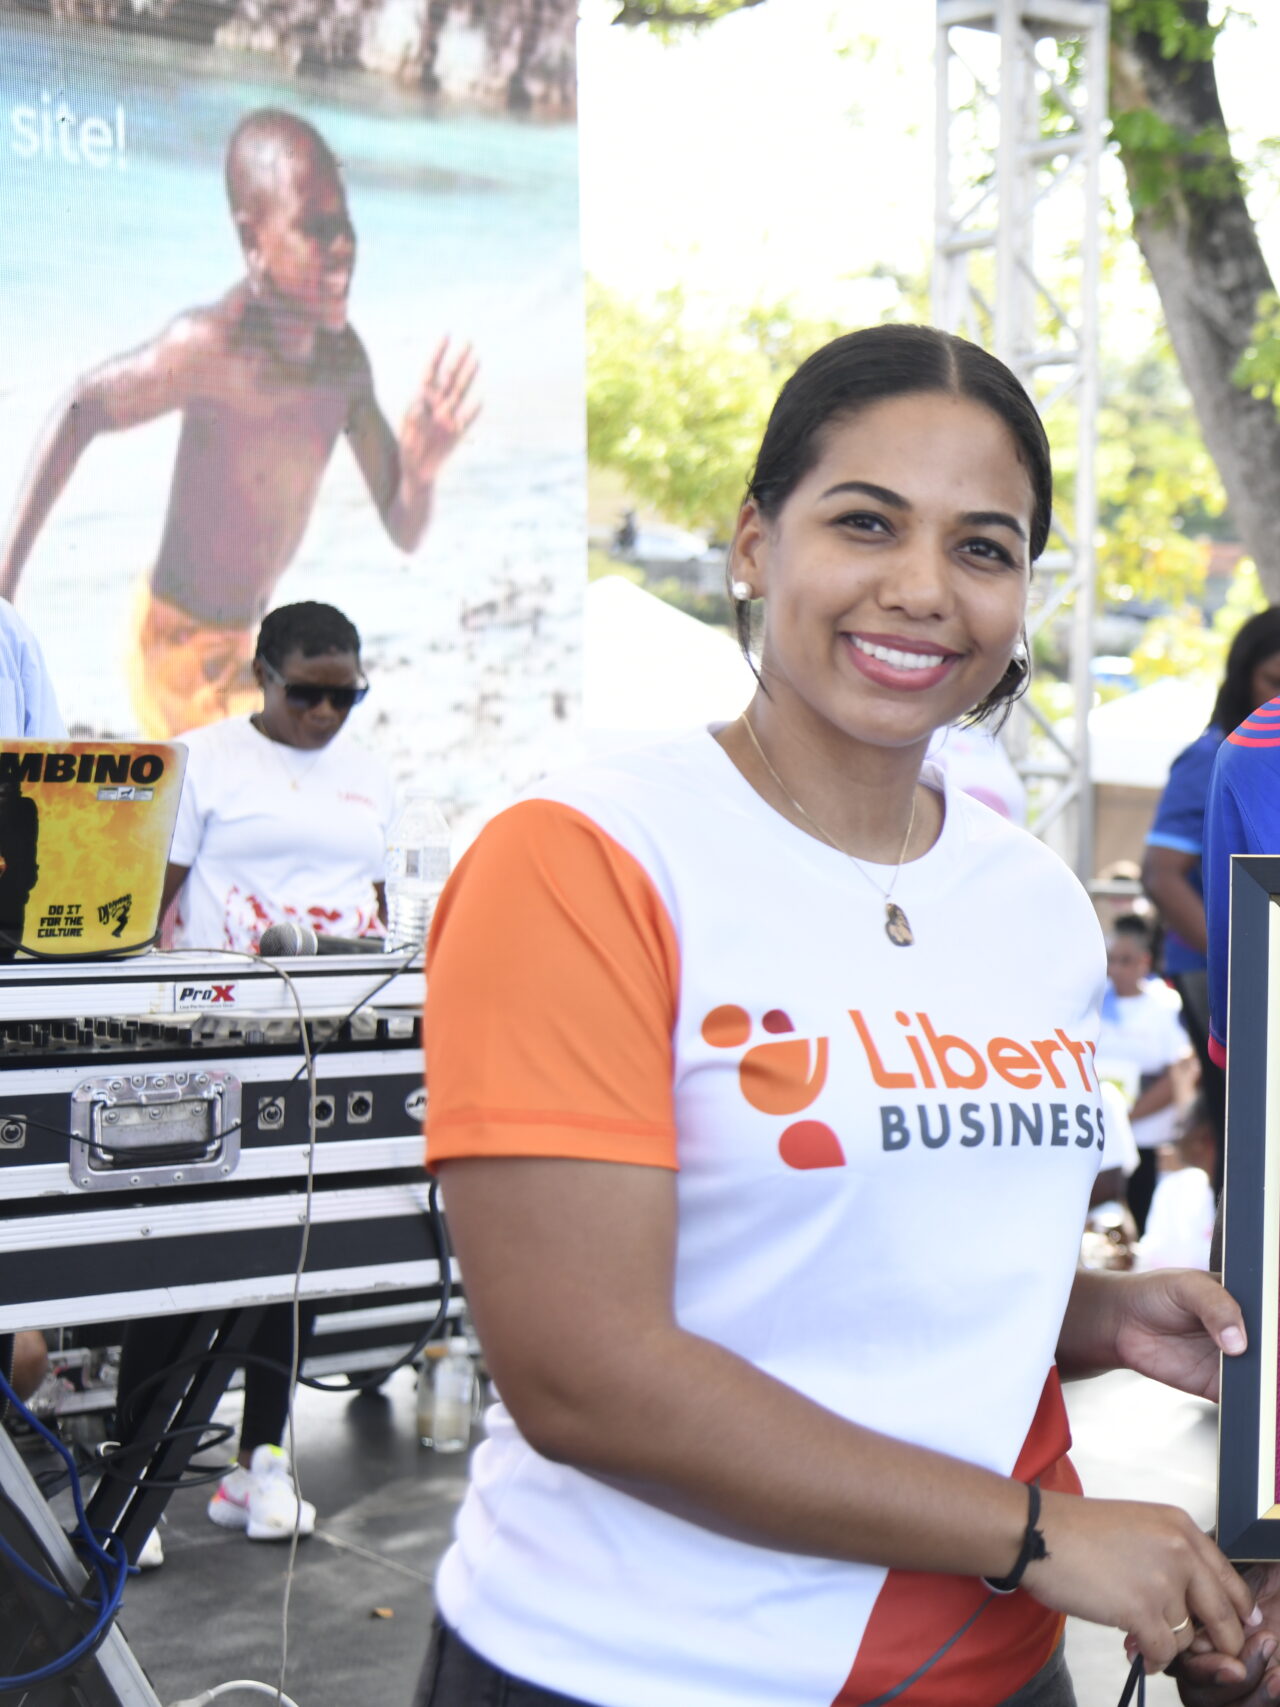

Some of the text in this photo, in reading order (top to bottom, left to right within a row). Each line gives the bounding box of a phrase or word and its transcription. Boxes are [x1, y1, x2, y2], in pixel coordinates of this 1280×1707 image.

[48, 904, 82, 915] DO IT
[40, 916, 83, 927] FOR THE
[37, 928, 83, 938] CULTURE
[180, 984, 235, 1002] ProX
[879, 1102, 1105, 1152] BUSINESS
